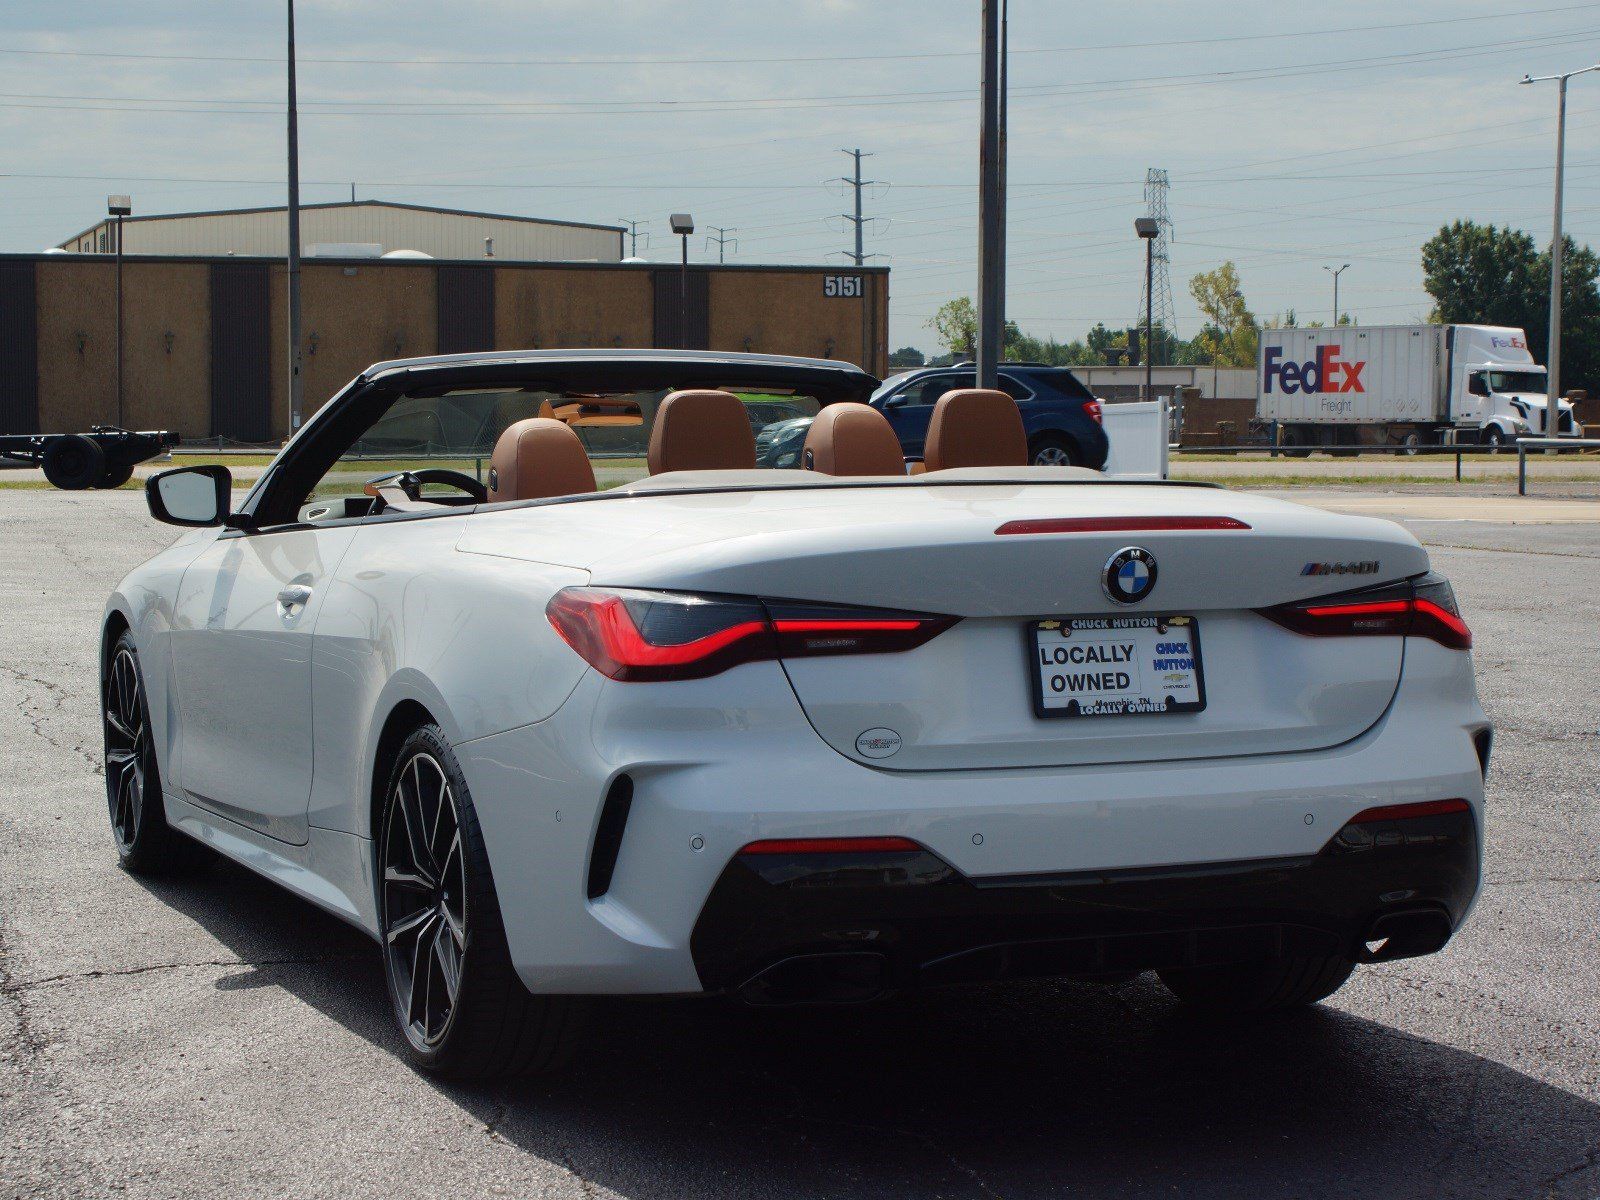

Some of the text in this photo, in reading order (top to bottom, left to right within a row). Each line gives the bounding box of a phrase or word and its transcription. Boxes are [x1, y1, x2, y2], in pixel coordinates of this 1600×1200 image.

[825, 276, 861, 296] 5151
[1264, 345, 1365, 394] FedEx
[1320, 398, 1352, 415] Freight
[1114, 550, 1155, 568] BMW
[1071, 618, 1158, 629] CHUCK HUTTON
[1041, 644, 1134, 665] LOCALLY
[1156, 643, 1189, 654] CHUCK
[1153, 658, 1195, 671] HUTTON
[1051, 672, 1130, 692] OWNED
[1080, 702, 1167, 715] LOCALLY OWNED
